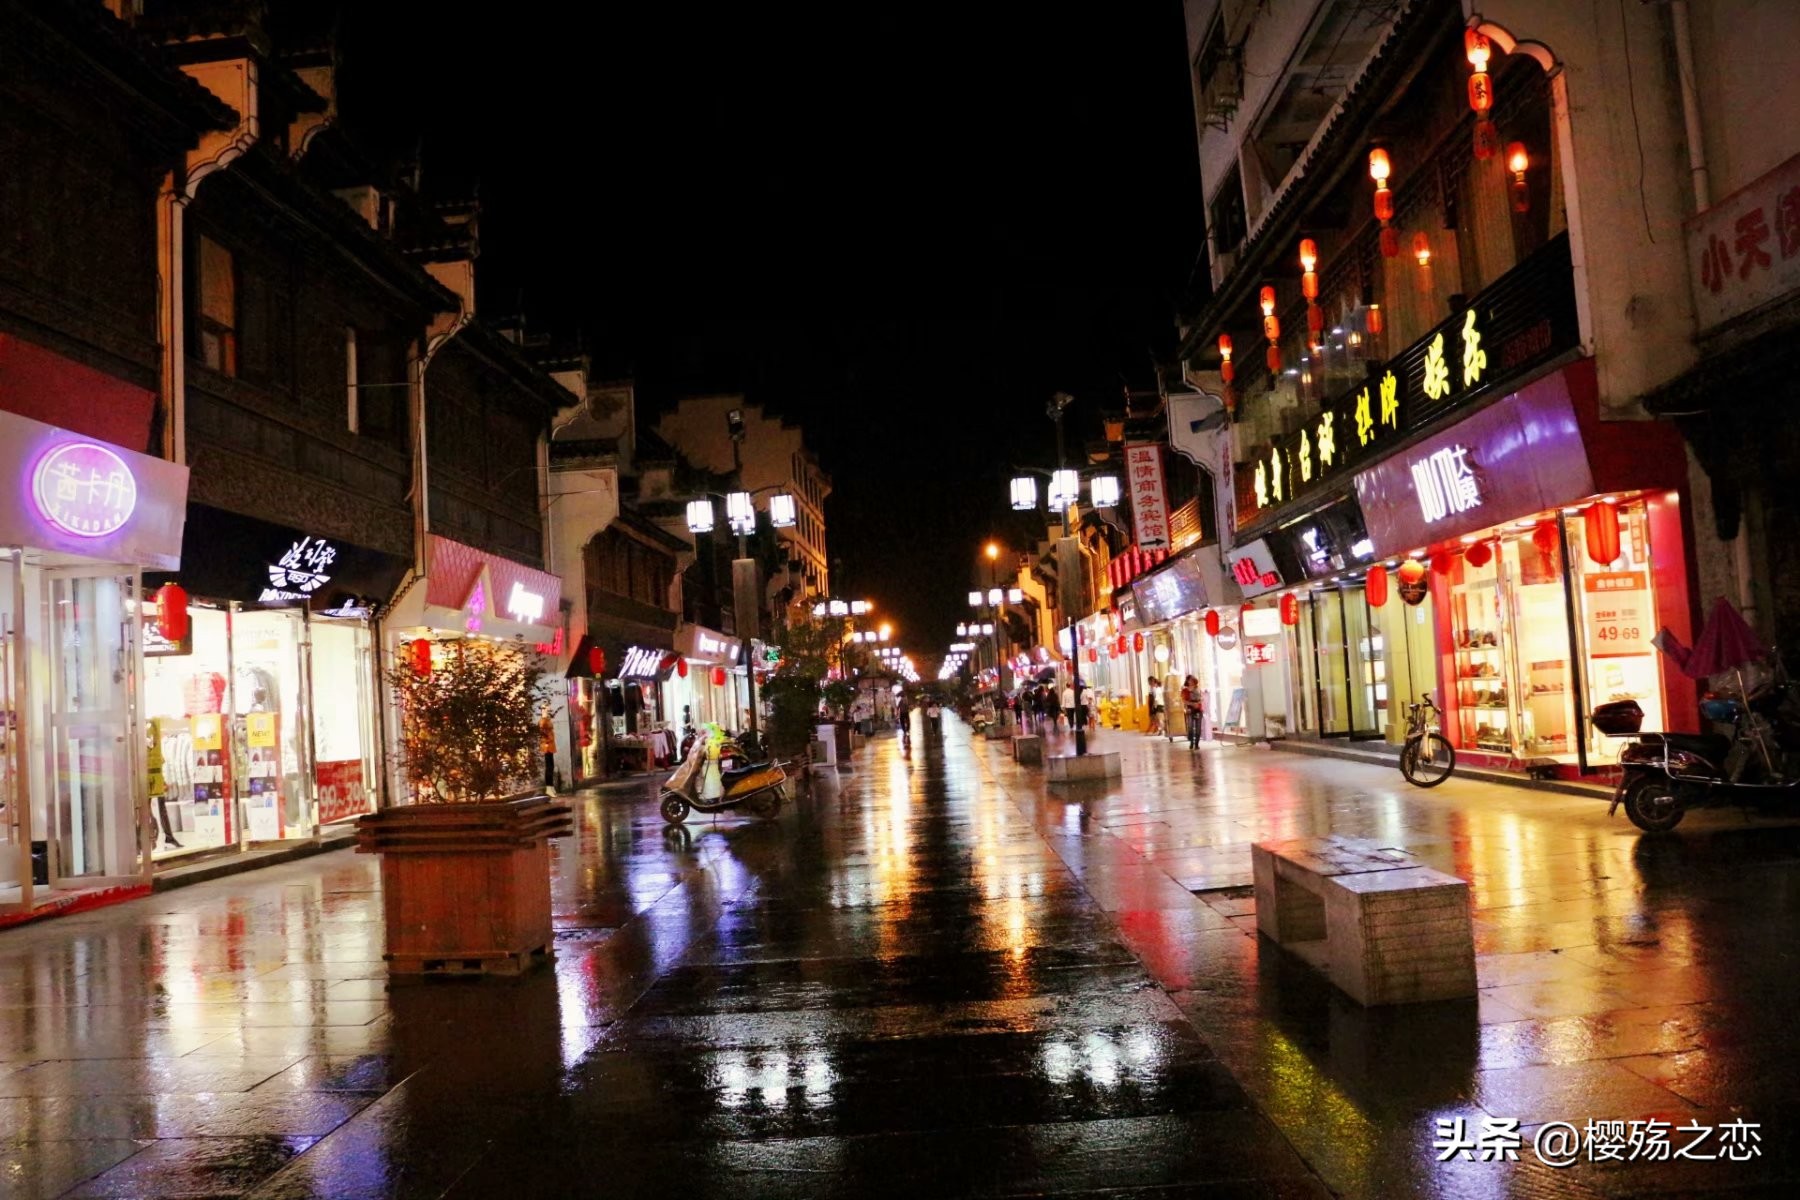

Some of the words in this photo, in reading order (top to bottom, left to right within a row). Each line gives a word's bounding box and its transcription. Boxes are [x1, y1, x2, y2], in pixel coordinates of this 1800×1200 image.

[1355, 370, 1399, 447] 棋牌
[1423, 309, 1486, 400] 娱乐
[1131, 450, 1164, 538] 温情商务宾馆
[287, 571, 309, 583] BSD
